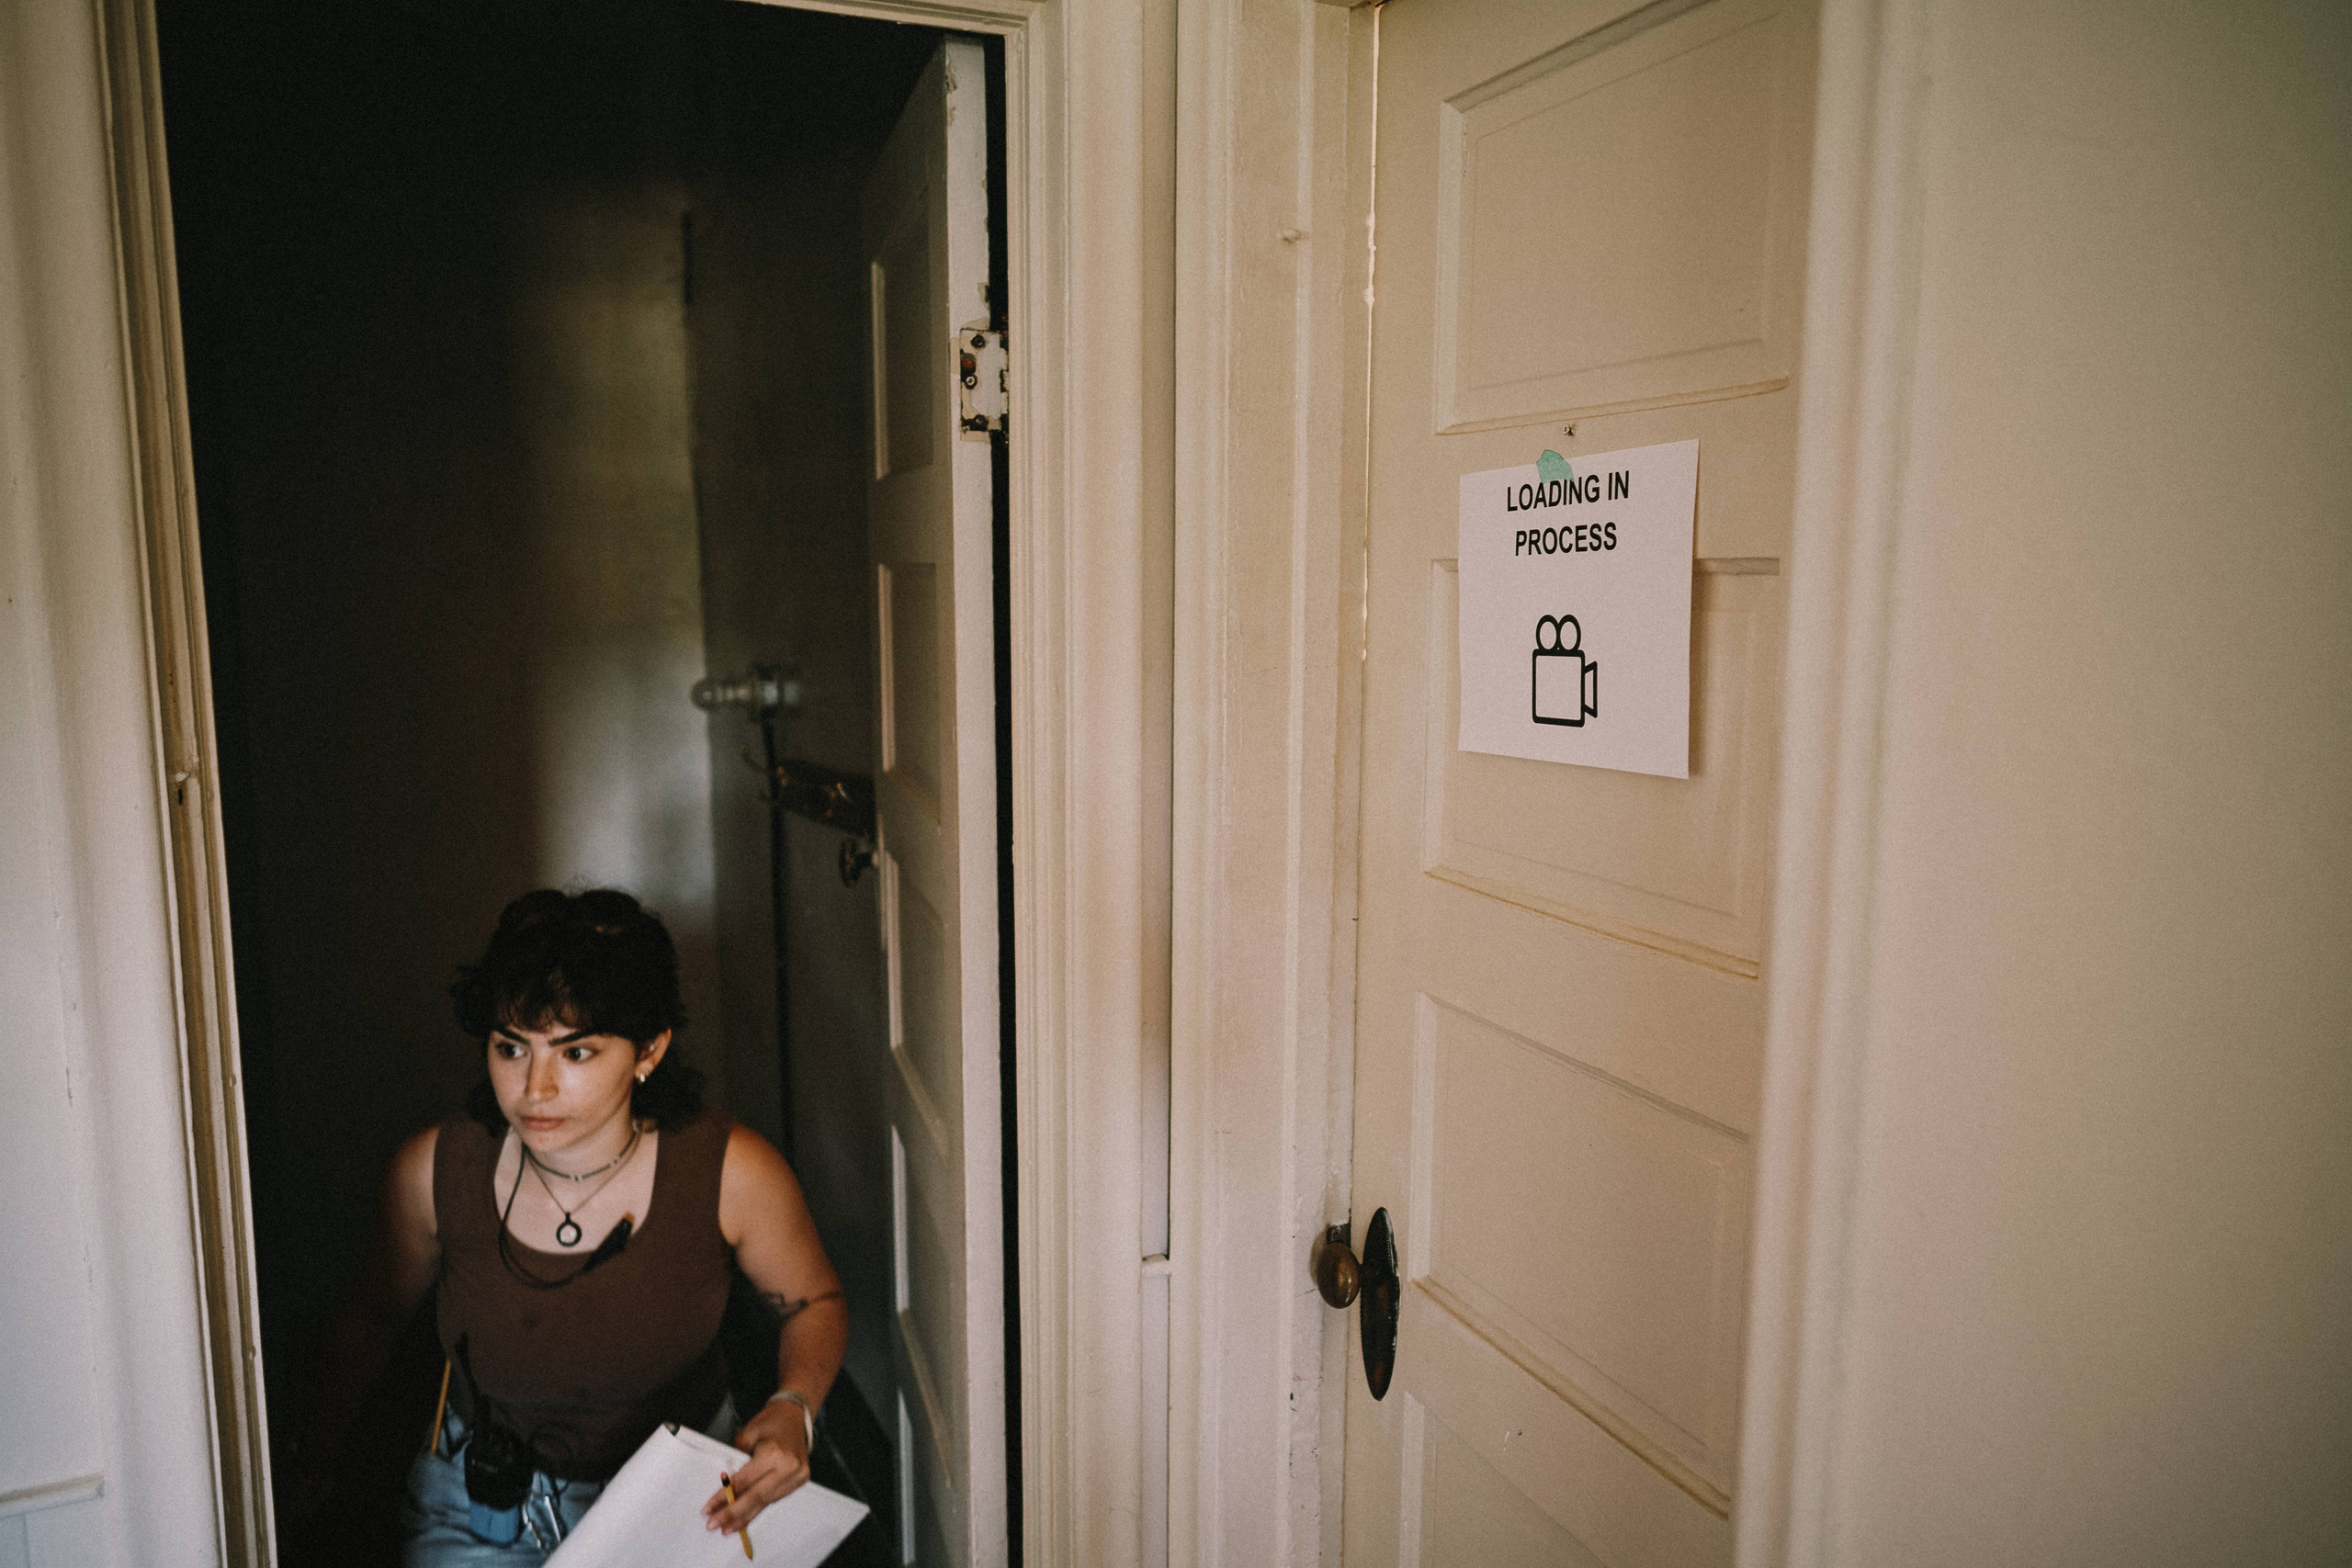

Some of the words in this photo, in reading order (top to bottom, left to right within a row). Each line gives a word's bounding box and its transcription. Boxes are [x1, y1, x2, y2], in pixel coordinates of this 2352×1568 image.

[1507, 474, 1600, 512] LOADING
[1608, 470, 1630, 501] IN
[1516, 522, 1617, 557] PROCESS
